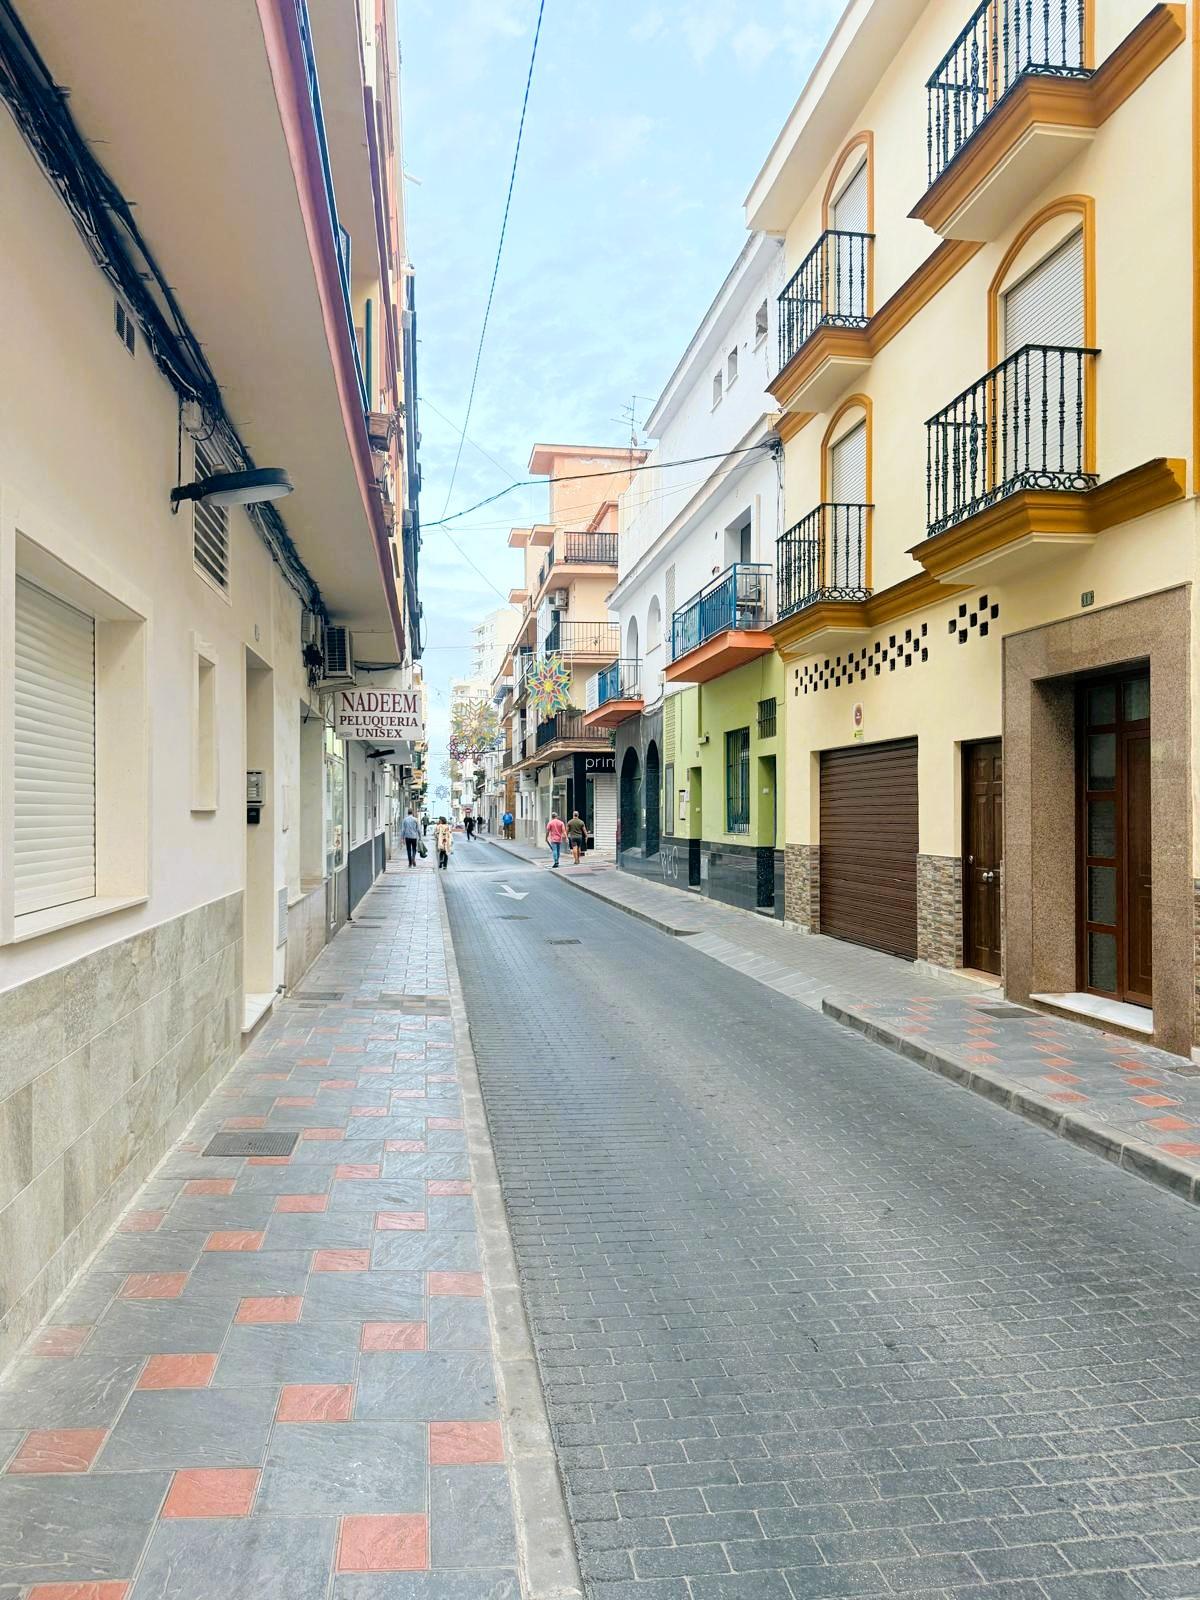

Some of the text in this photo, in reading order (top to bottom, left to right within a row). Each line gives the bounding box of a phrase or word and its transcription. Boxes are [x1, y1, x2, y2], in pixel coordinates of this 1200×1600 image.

[341, 692, 418, 713] NADEEM
[339, 715, 419, 729] PELUQUERIA
[355, 728, 402, 738] UNISEX
